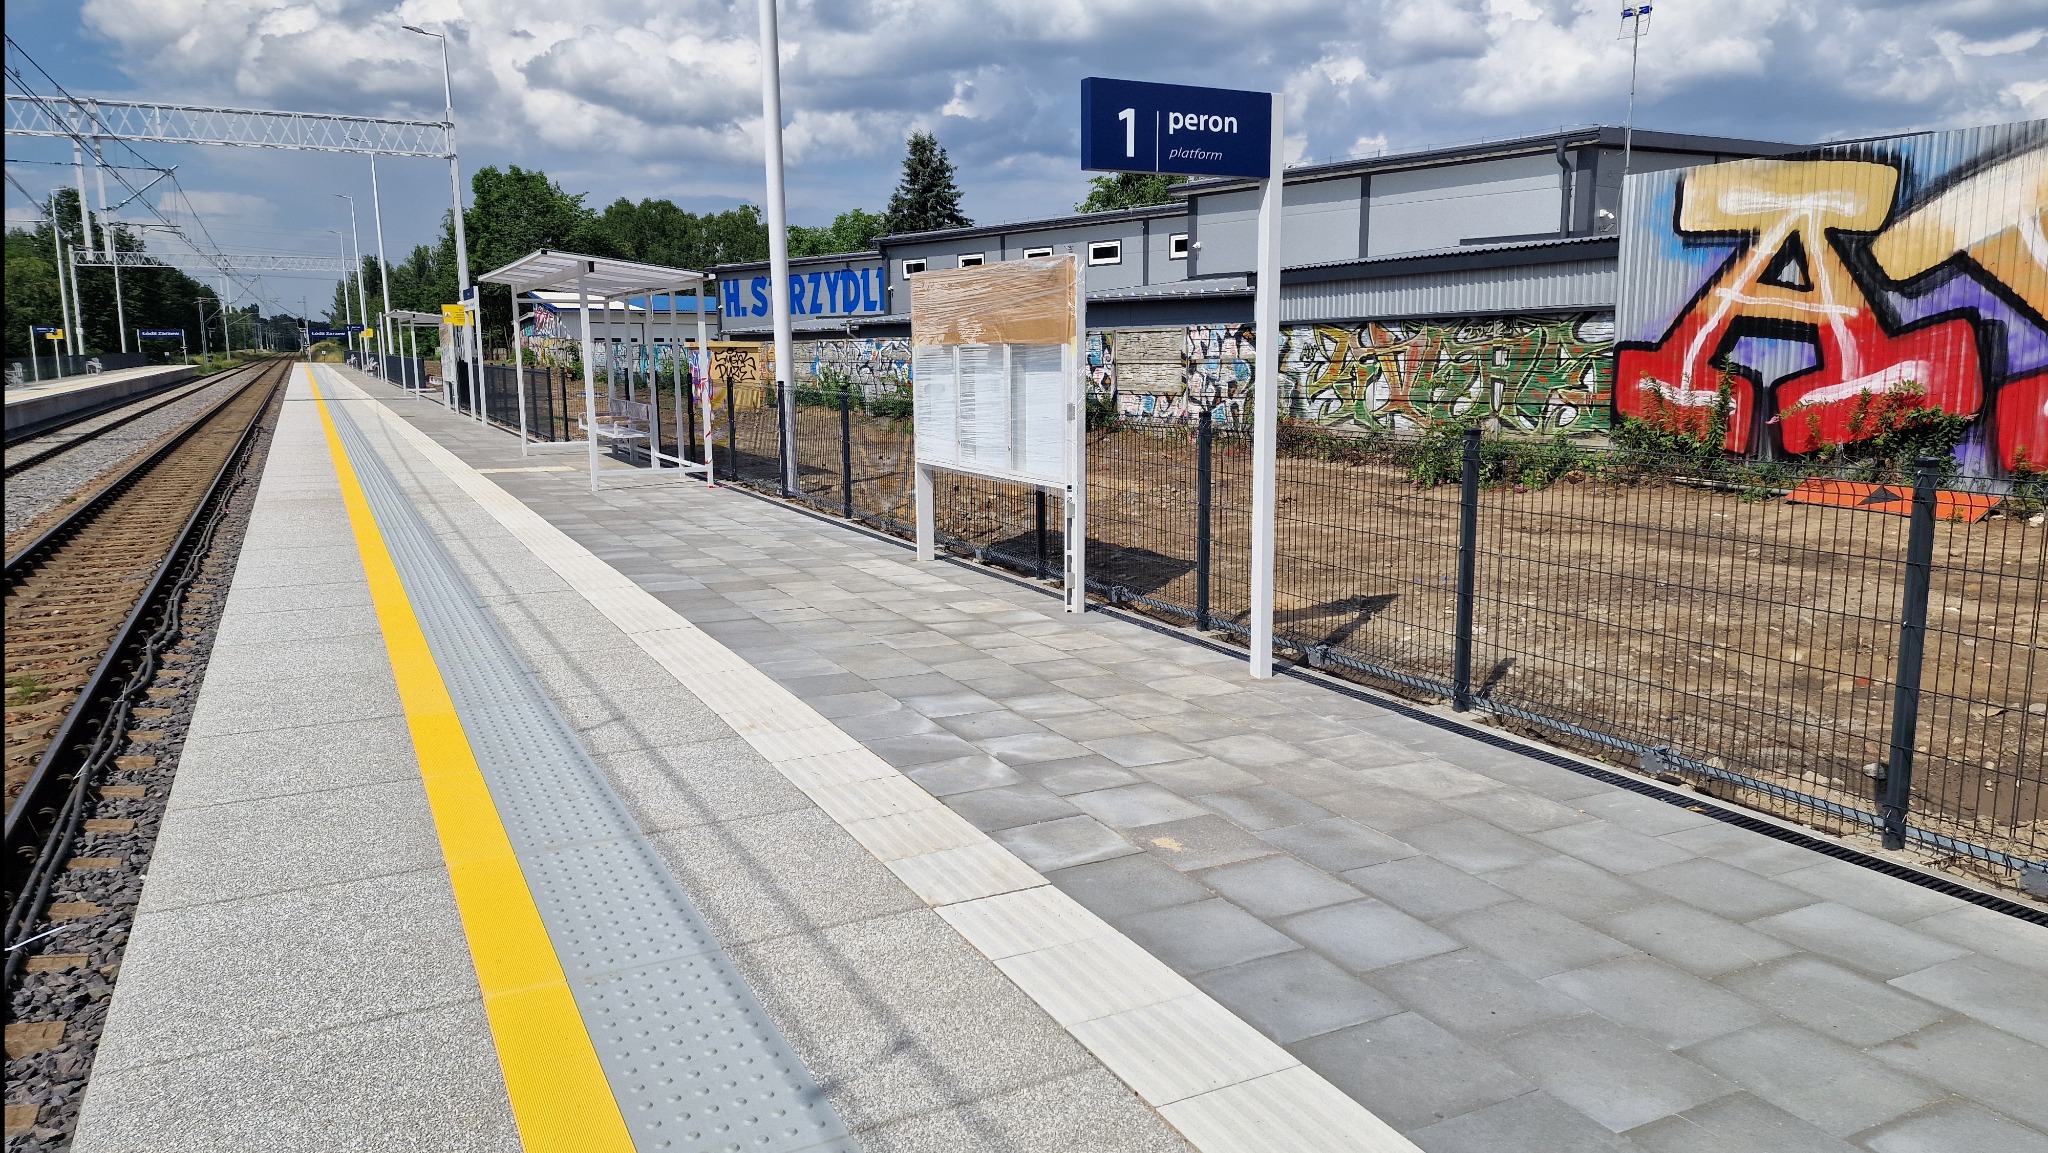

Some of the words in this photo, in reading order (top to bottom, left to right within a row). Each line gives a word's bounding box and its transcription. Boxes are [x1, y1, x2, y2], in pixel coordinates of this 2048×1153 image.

[1118, 107, 1136, 158] 1
[1168, 111, 1238, 135] peron
[1168, 146, 1223, 161] platform
[723, 278, 747, 318] H.
